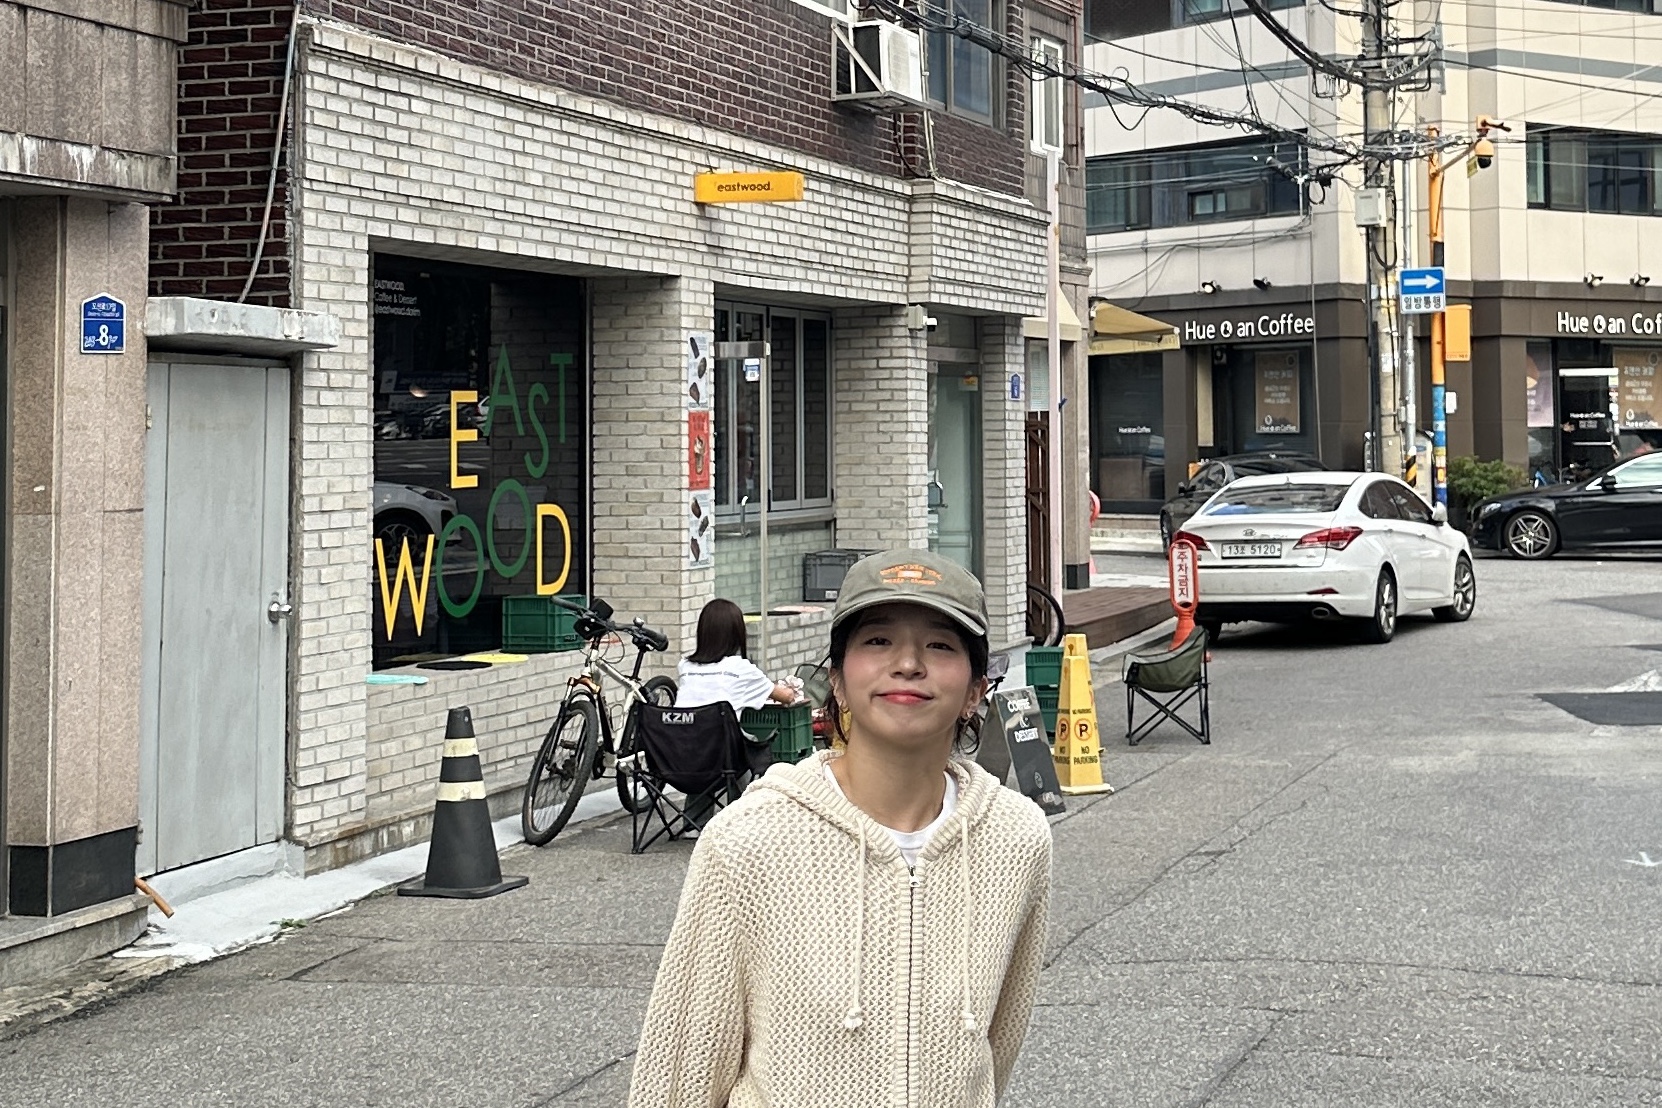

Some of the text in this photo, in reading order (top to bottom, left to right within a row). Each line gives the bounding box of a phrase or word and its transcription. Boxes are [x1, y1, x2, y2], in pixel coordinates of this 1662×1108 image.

[1404, 295, 1441, 310] 일방통행
[1185, 320, 1216, 340] Hue
[1236, 321, 1255, 337] an
[1257, 312, 1315, 336] Coffee
[1557, 311, 1589, 333] Hue
[1607, 317, 1626, 334] an
[1250, 544, 1276, 555] 5120
[1177, 551, 1189, 598] 주차금지
[661, 711, 695, 724] KZM
[1081, 745, 1090, 754] NO
[1073, 755, 1099, 765] PARKING
